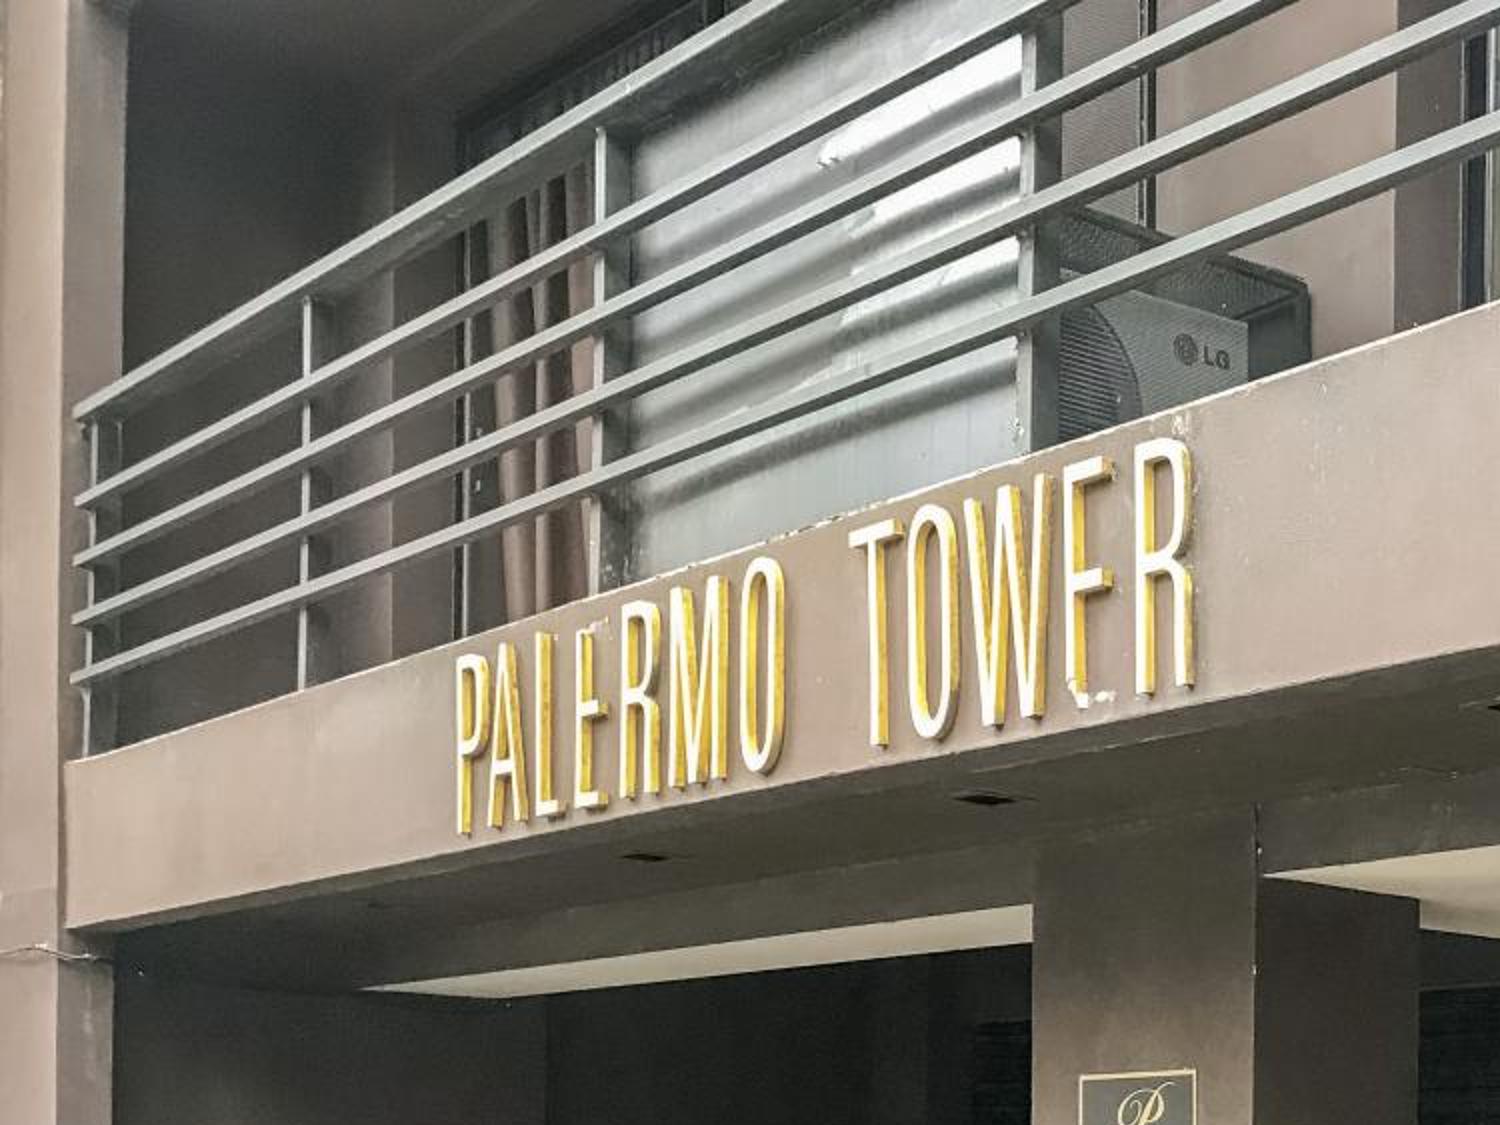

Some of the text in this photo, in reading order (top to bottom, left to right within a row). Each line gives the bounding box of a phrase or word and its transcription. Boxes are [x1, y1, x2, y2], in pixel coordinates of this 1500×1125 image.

[1202, 344, 1231, 370] LG
[455, 437, 1196, 836] PALERMO TOWER
